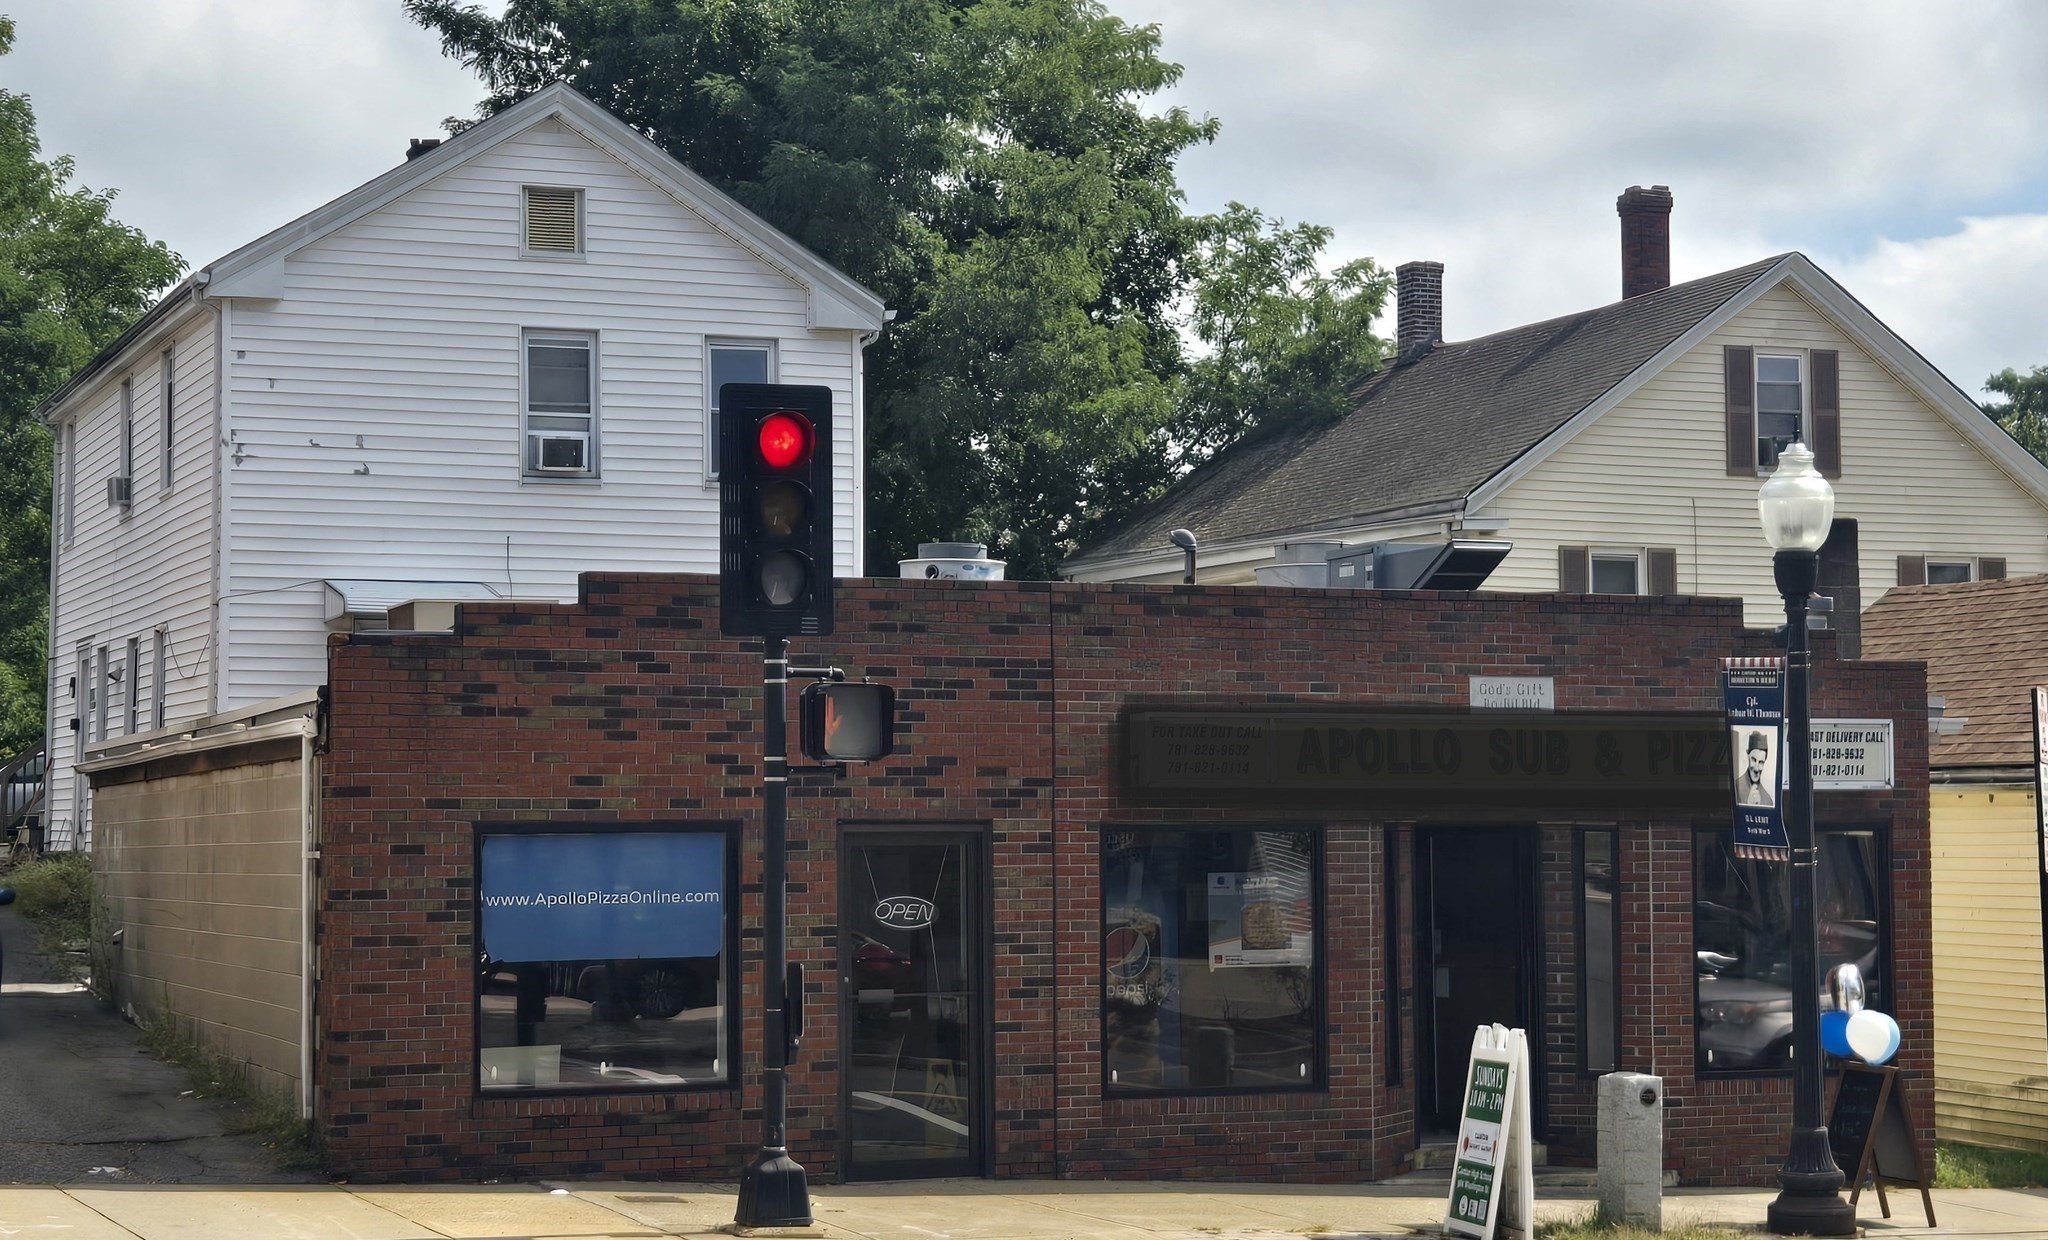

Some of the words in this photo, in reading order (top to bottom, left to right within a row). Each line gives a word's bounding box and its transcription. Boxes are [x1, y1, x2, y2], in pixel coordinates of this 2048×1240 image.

[1517, 683, 1545, 695] Gift
[1152, 726, 1174, 738] FOR
[1179, 726, 1207, 738] TAKE
[1210, 726, 1233, 738] OUT
[1236, 726, 1264, 738] CALL
[1826, 731, 1864, 743] DELIVERY
[1865, 731, 1885, 743] CALL
[1167, 743, 1250, 756] 781-828-9632
[1296, 727, 1463, 775] APOLLO
[1488, 727, 1570, 775] SUB
[1594, 731, 1627, 776] &
[1647, 730, 1727, 776] PIZZ
[1810, 748, 1864, 759] 81-828-9632
[1167, 761, 1250, 774] 781-821-0114
[1811, 765, 1864, 776] 81-821-0114
[486, 889, 719, 908] www.ApolloPizzaOnline.com
[875, 902, 935, 921] OPEN
[1475, 1065, 1505, 1089] SUNDAYS
